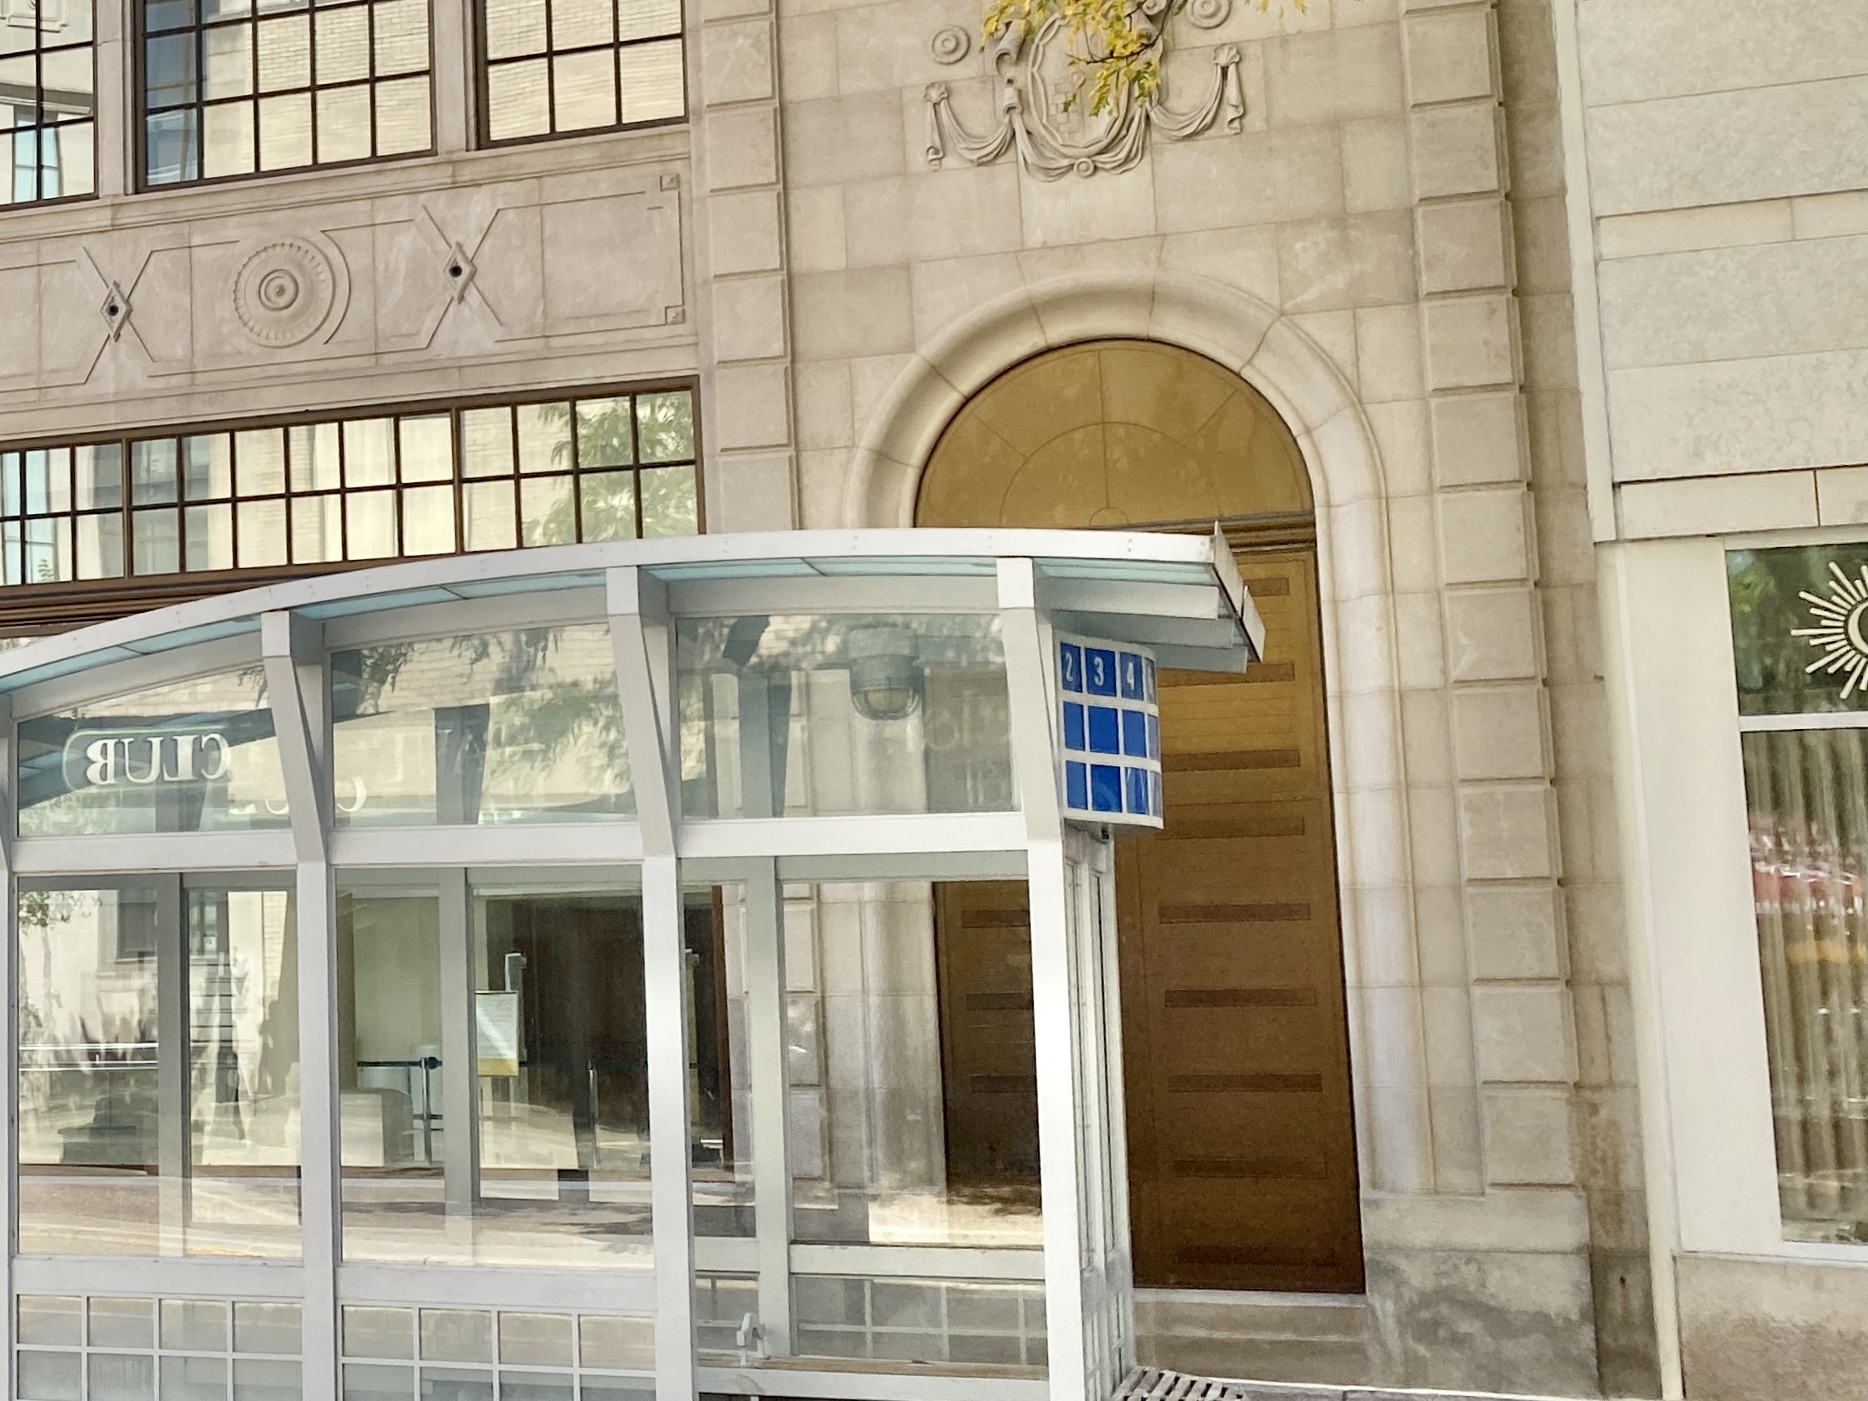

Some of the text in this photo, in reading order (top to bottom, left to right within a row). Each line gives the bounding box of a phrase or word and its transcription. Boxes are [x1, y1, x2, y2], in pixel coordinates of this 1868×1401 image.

[1065, 652, 1074, 682] 2
[1094, 656, 1104, 687] 3
[1127, 661, 1135, 690] 4
